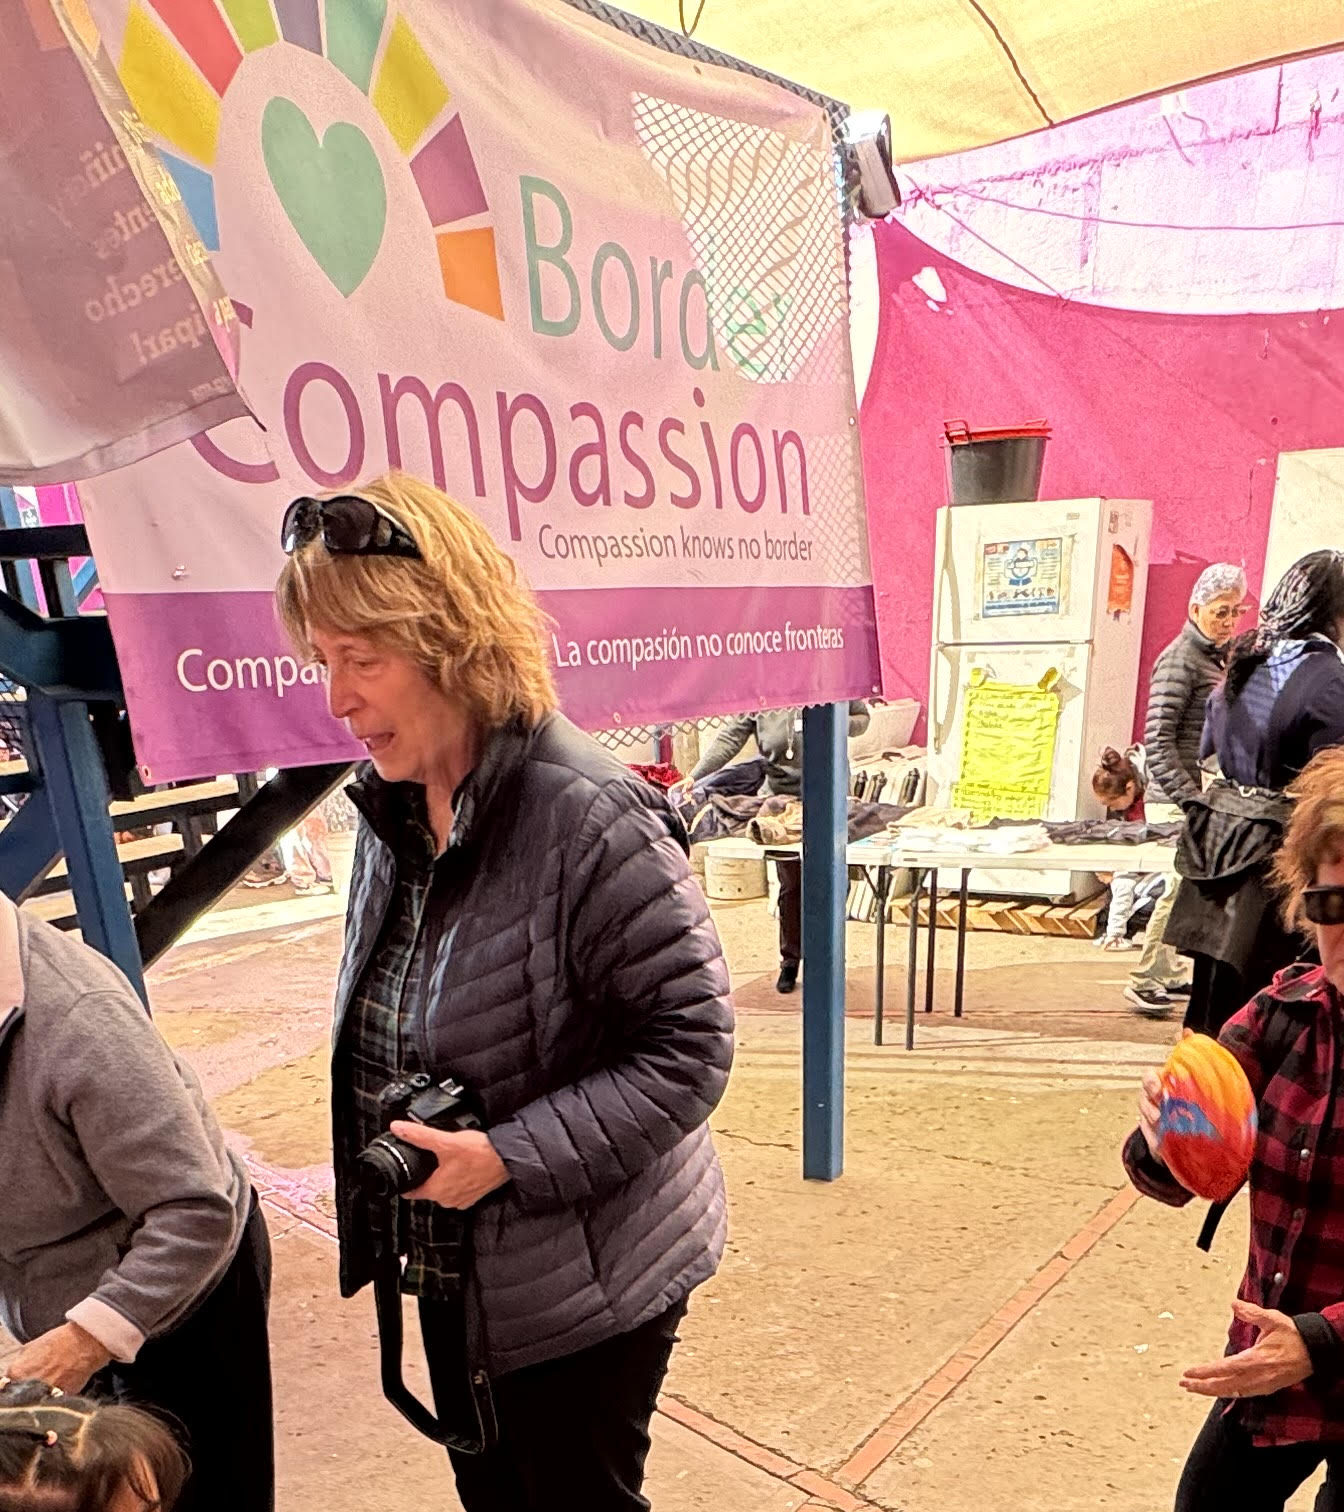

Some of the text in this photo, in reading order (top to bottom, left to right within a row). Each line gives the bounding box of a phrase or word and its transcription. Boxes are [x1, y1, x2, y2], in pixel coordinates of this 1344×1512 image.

[538, 524, 813, 567] Compassion knows no border
[552, 620, 844, 671] La compasión no conoce fronteras
[177, 648, 329, 697] Compa
